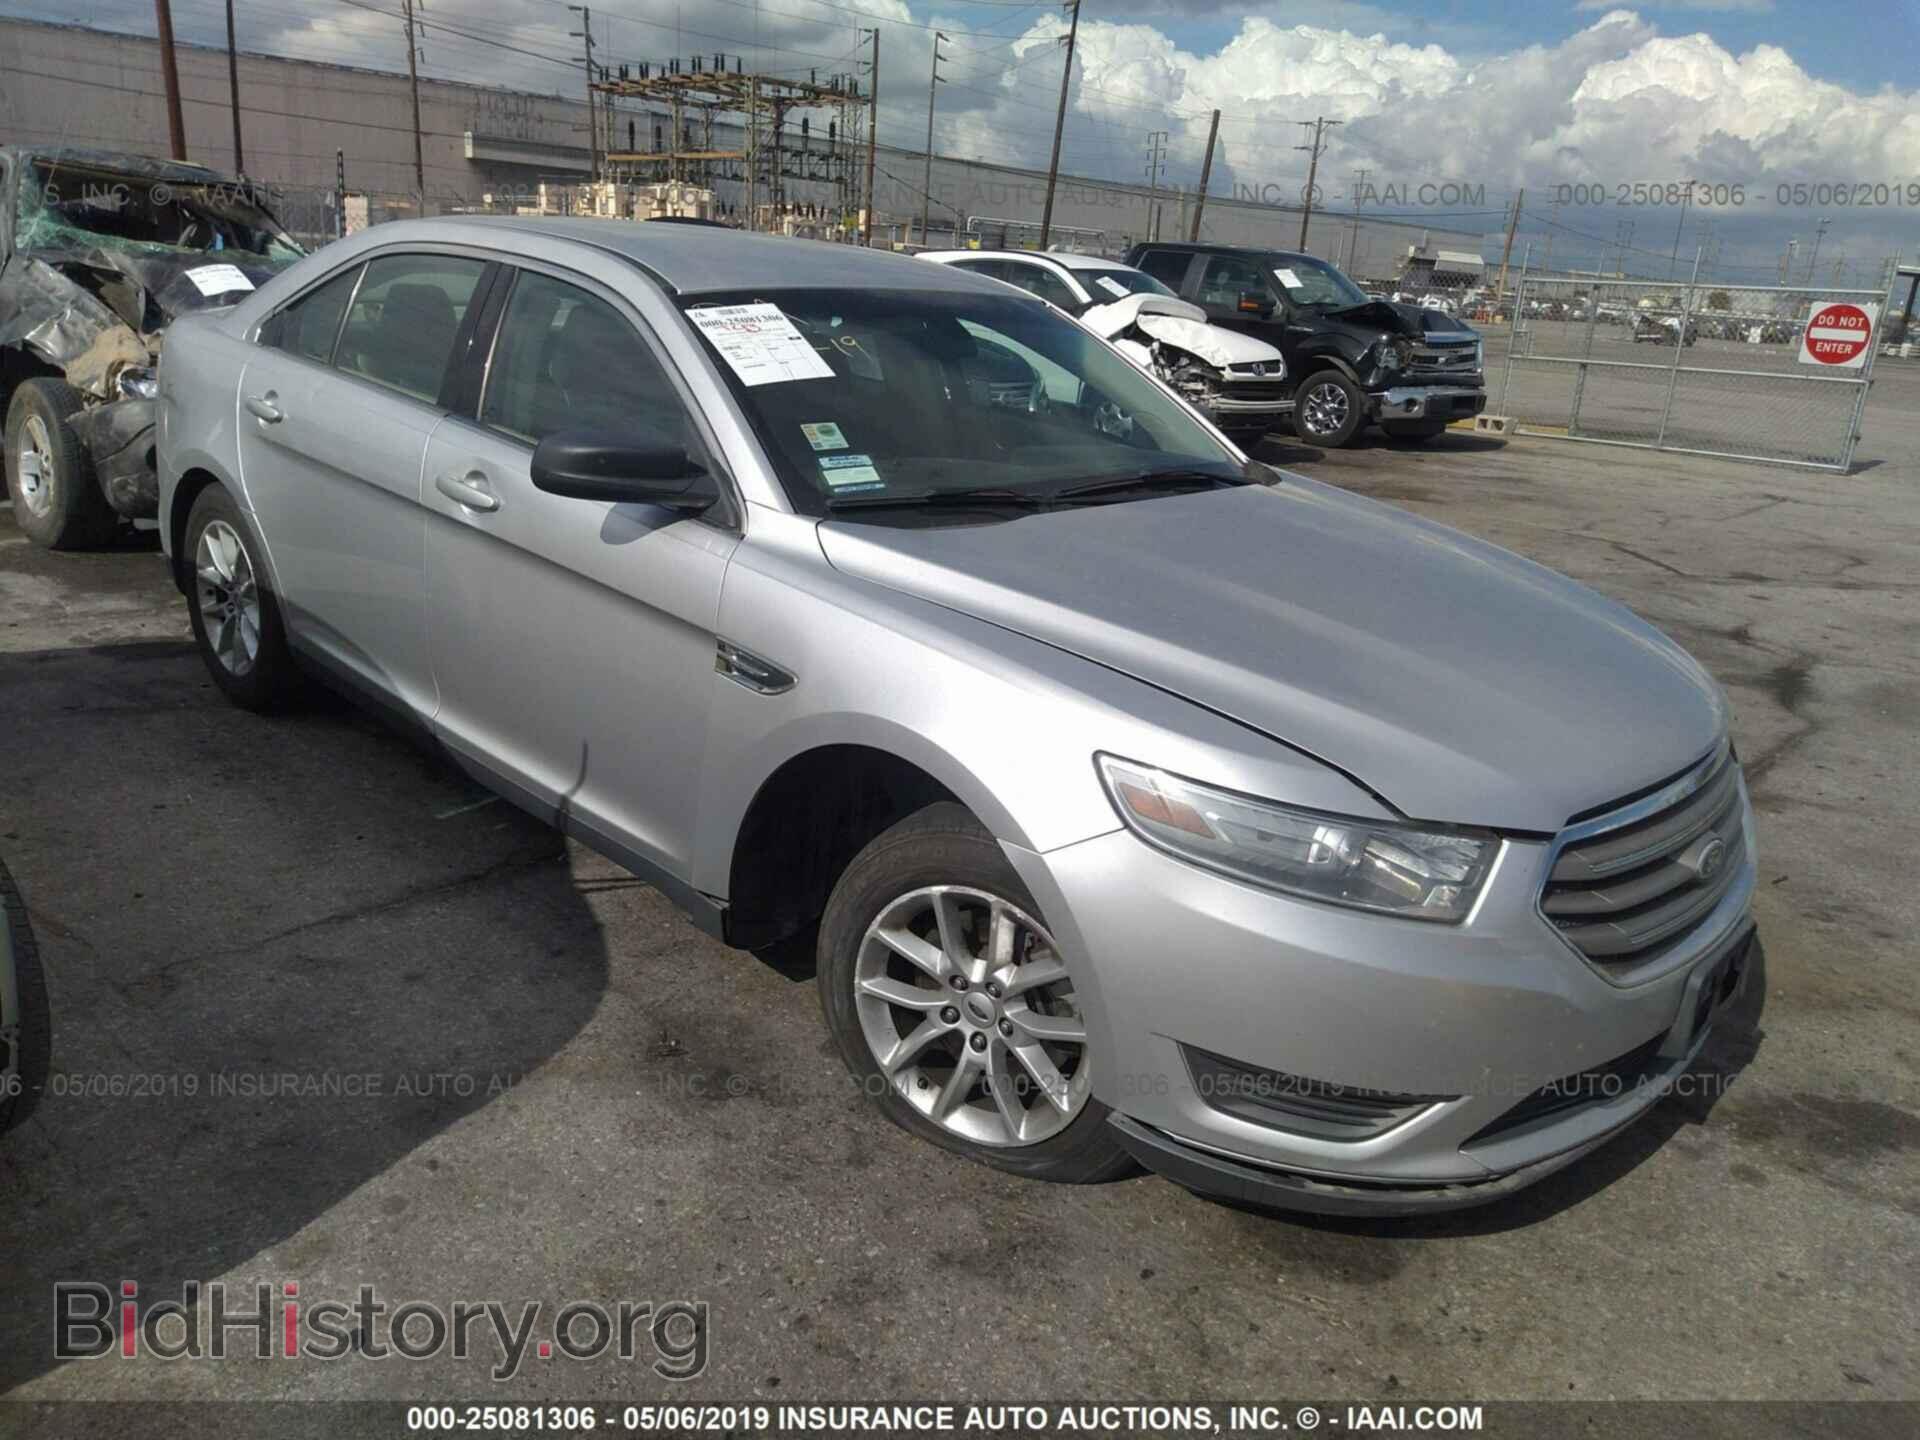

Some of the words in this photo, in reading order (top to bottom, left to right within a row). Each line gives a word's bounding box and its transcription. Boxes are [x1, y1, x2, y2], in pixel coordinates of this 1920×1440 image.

[1817, 314, 1834, 326] DO
[1839, 315, 1865, 328] NOT
[1815, 341, 1853, 354] ENTER
